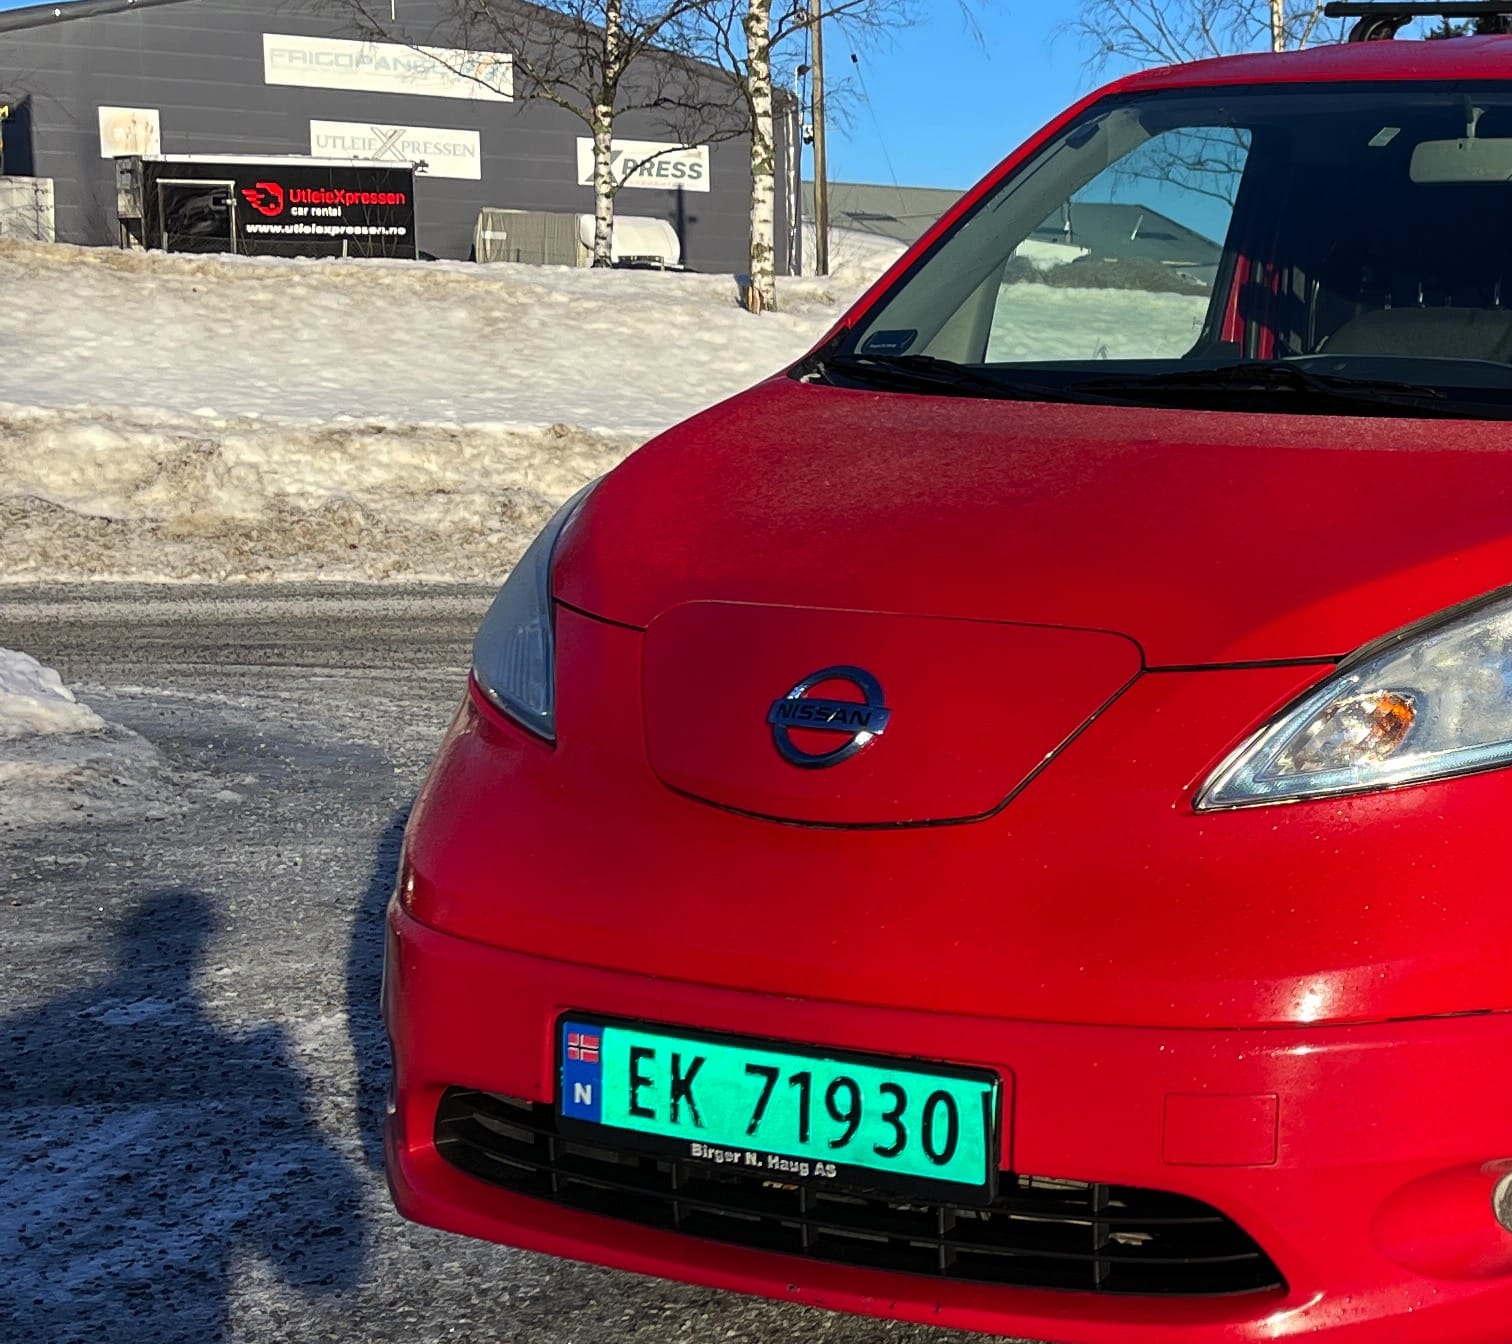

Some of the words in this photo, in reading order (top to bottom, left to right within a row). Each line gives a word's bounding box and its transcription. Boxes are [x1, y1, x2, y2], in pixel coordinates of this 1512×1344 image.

[289, 188, 406, 206] UtleieXpressen
[291, 206, 308, 216] car
[311, 206, 342, 217] rental
[246, 223, 407, 236] www.utleiexpressen.no
[775, 703, 872, 726] NISSAN
[574, 1082, 592, 1106] N
[628, 1045, 706, 1129] EK
[744, 1063, 959, 1166] 71930
[691, 1142, 741, 1163] Birger
[745, 1152, 763, 1167] N.
[767, 1155, 809, 1176] Haug
[814, 1162, 837, 1178] AS
